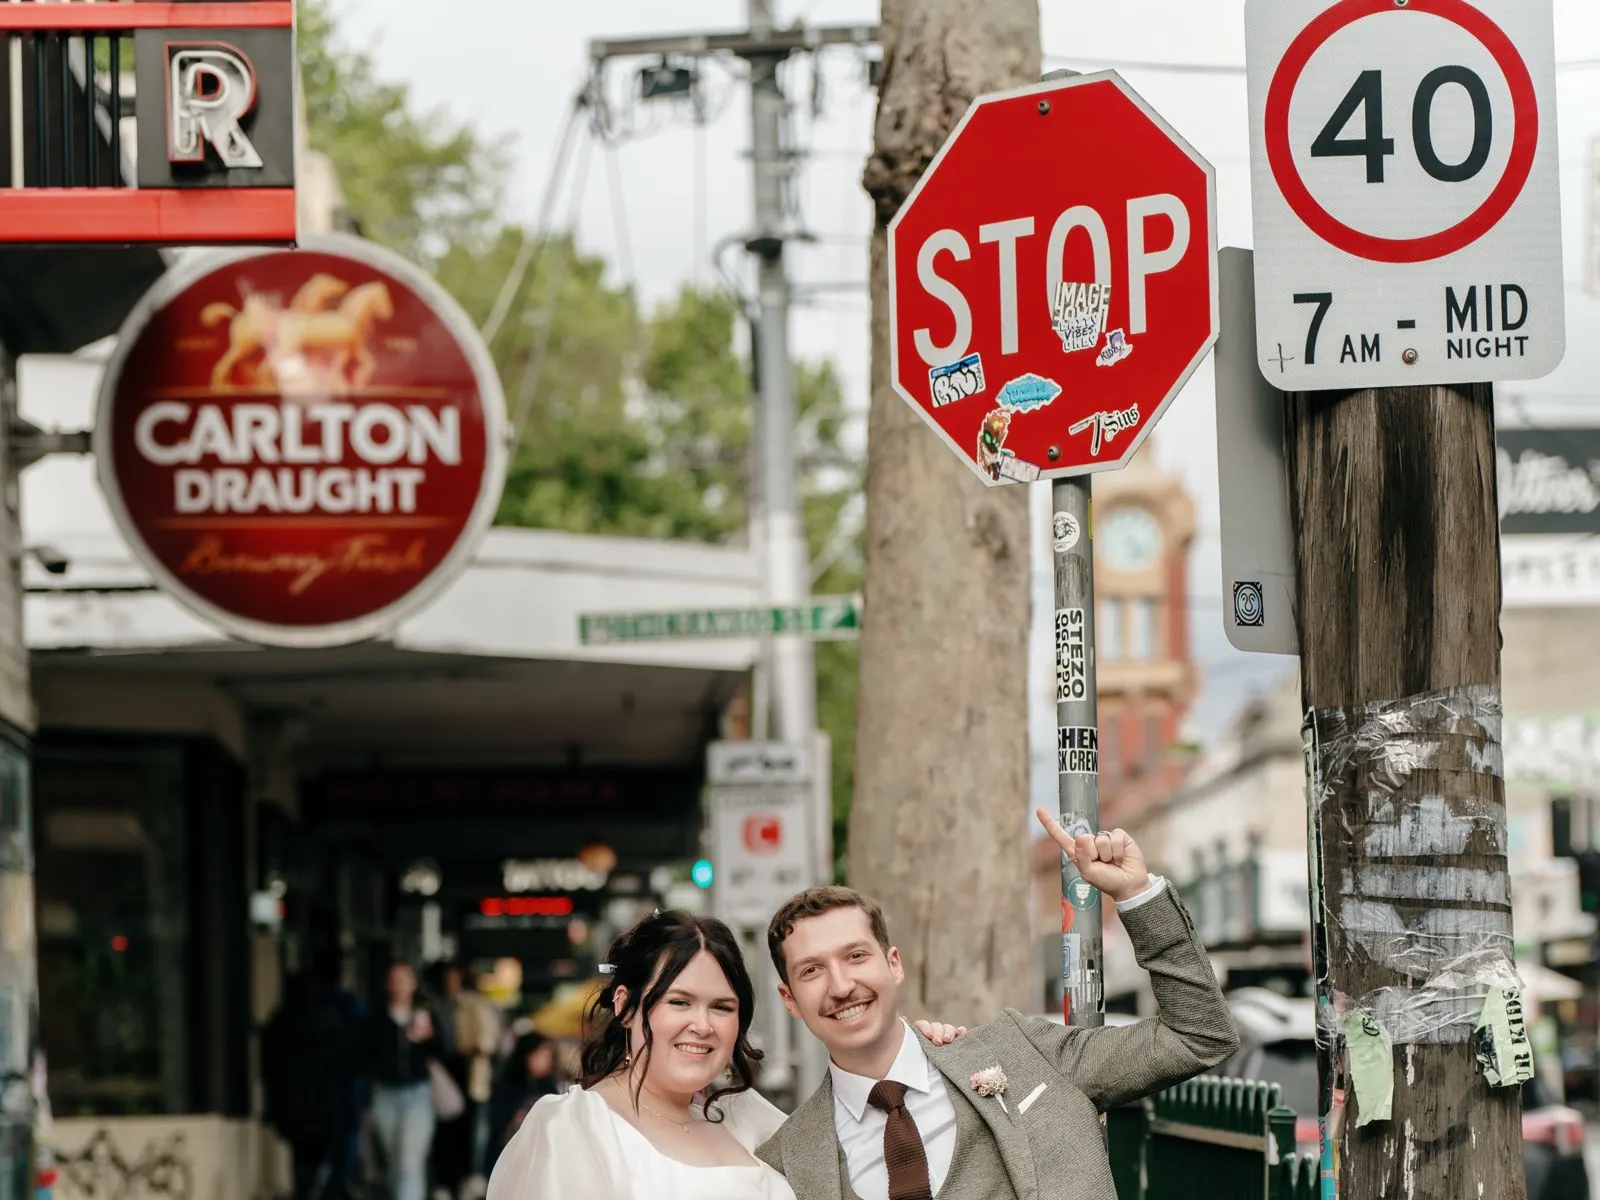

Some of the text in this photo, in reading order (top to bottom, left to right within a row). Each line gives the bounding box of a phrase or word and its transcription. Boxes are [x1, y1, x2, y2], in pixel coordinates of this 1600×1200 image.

[163, 40, 264, 167] R
[1310, 64, 1493, 184] 40
[912, 193, 1191, 368] STOP
[1064, 325, 1096, 341] VIBES
[1292, 291, 1333, 365] 7
[1339, 333, 1381, 364] AM
[1445, 283, 1528, 334] MID
[1446, 335, 1529, 360] NIGHT
[135, 401, 461, 465] CARLTON
[174, 468, 425, 513] DRAUGHT
[1069, 609, 1085, 698] STEZO
[1502, 986, 1528, 1046] KIDS
